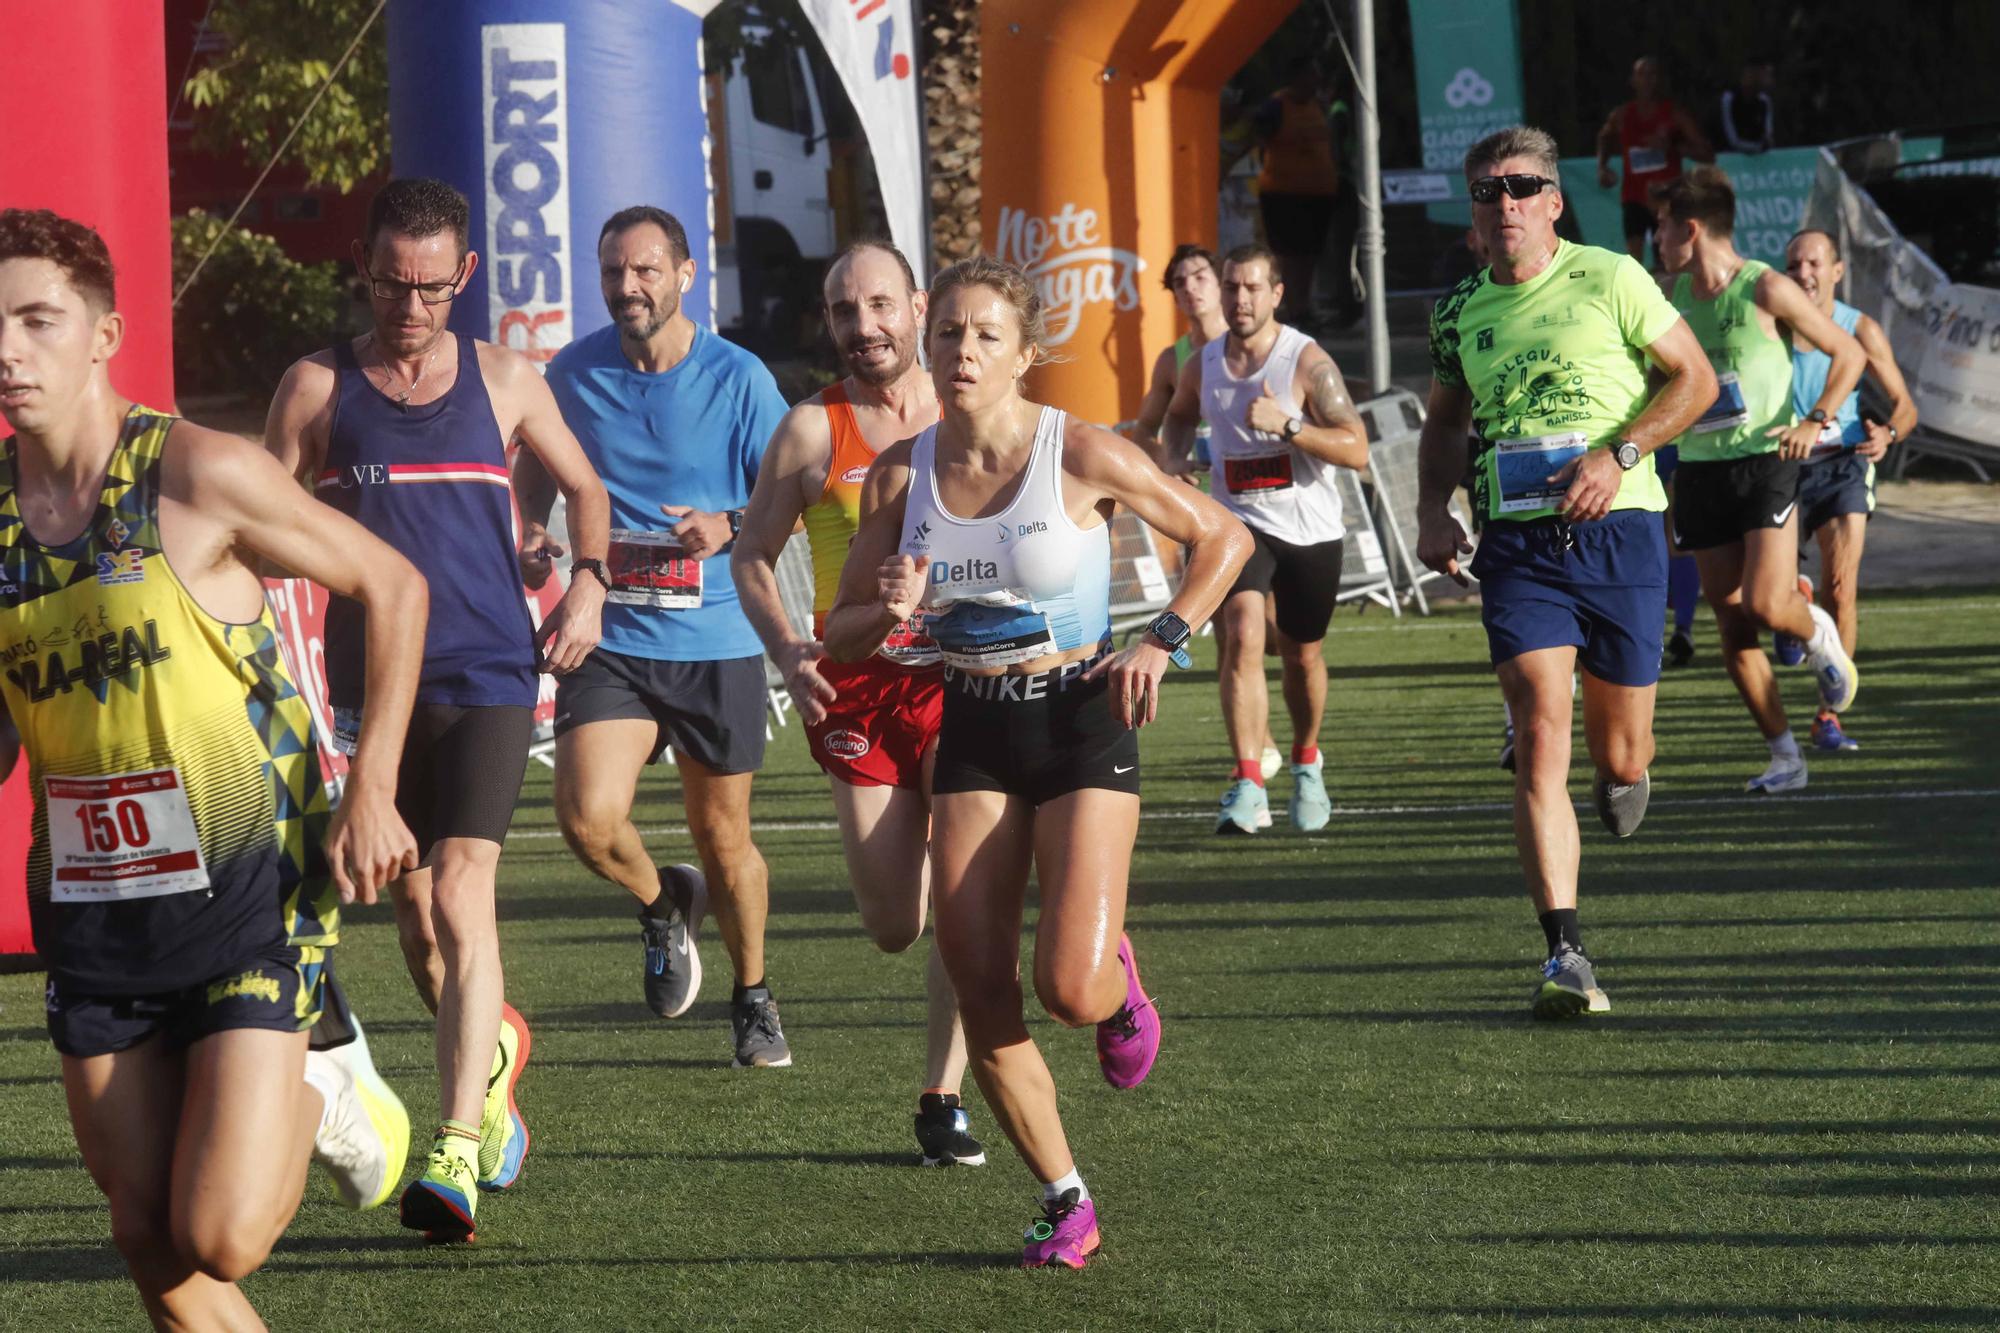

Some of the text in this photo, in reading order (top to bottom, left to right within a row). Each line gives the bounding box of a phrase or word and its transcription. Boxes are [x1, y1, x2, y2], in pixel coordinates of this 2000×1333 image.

[1050, 203, 1100, 249] te
[1546, 411, 1592, 426] MANISES
[1018, 521, 1048, 537] Delta
[931, 558, 999, 585] Delta
[961, 669, 1049, 701] NIKE
[75, 799, 150, 853] 150
